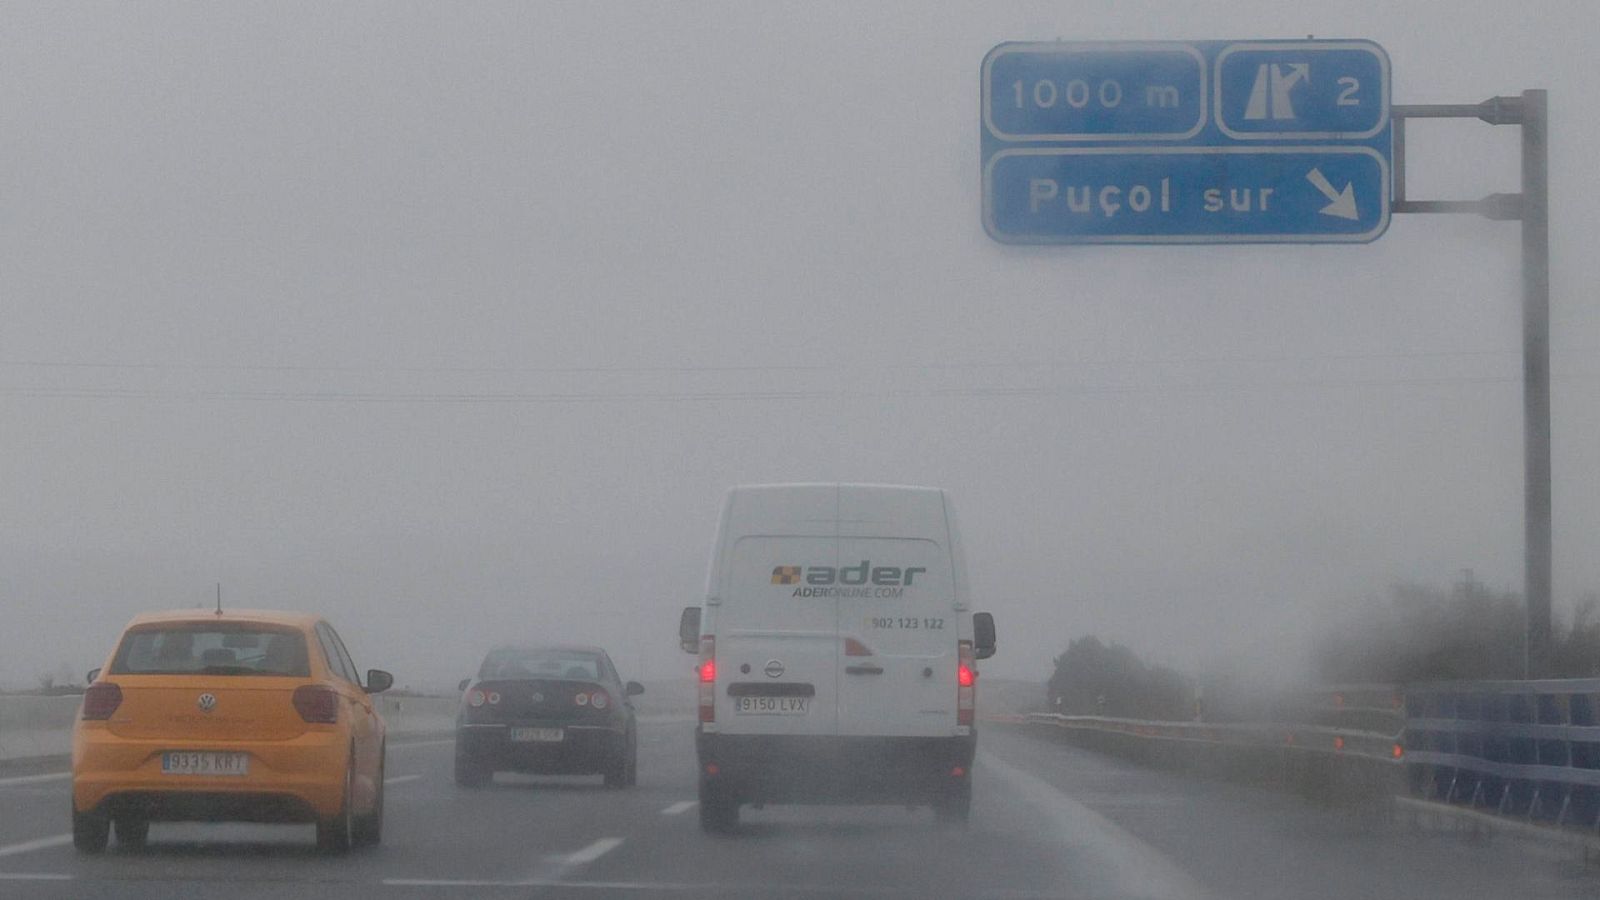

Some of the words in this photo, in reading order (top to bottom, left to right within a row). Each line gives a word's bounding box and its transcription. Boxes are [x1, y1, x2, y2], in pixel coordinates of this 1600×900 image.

[1012, 80, 1123, 109] 1000
[1146, 86, 1179, 108] m
[1336, 77, 1361, 106] 2
[1030, 177, 1171, 218] Puçol
[1203, 187, 1274, 213] sur
[806, 560, 926, 586] ader
[872, 618, 893, 629] 902
[899, 618, 918, 629] 123
[924, 618, 944, 629] 122
[742, 698, 776, 711] 9150
[781, 698, 805, 711] LVX
[172, 754, 209, 769] 9335
[215, 754, 243, 769] KRT
